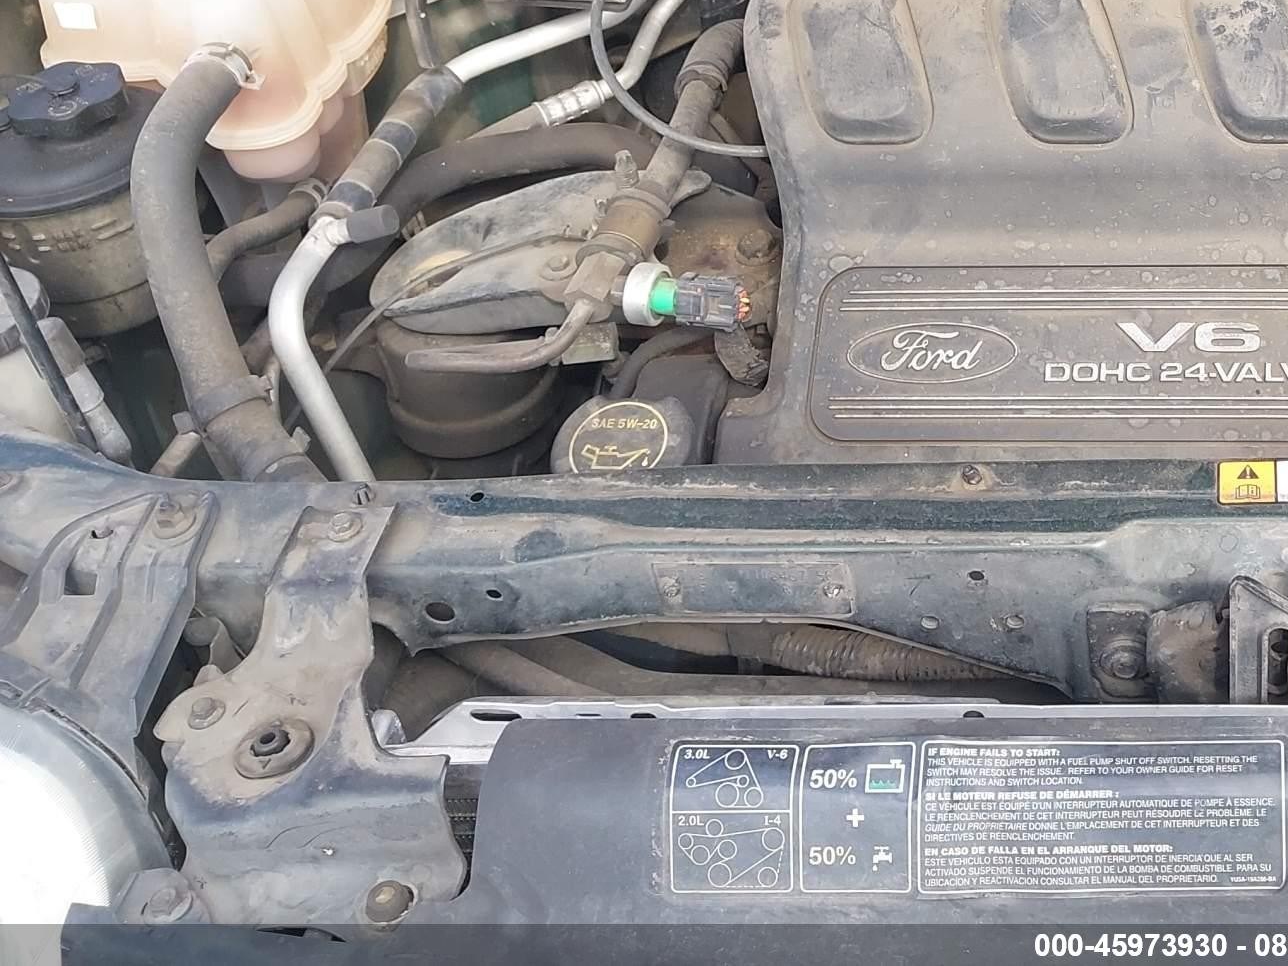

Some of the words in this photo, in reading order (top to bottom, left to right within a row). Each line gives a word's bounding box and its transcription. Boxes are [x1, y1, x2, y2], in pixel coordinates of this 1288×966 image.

[1116, 321, 1263, 352] V6
[880, 329, 983, 371] Ford
[1044, 362, 1152, 383] DOHC
[591, 418, 614, 428] SAE
[617, 418, 658, 429] 5W-20
[684, 750, 710, 759] 3.0L
[767, 750, 788, 759] V-6
[928, 748, 937, 756] IF
[940, 748, 977, 756] ENGINE
[980, 748, 1007, 756] FAILS
[1010, 748, 1024, 756] TO
[1026, 748, 1060, 756] START:
[928, 758, 945, 766] THIS
[947, 758, 983, 766] VEHICLE
[1038, 757, 1058, 765] WITH
[1060, 757, 1066, 765] A
[1068, 757, 1088, 765] FUEL
[927, 768, 958, 776] SWITCH
[960, 768, 977, 776] MAY
[979, 767, 1017, 776] RESOLVE
[1019, 767, 1034, 775] THE
[1068, 766, 1095, 774] REFER
[1098, 766, 1109, 774] TO
[1111, 766, 1134, 774] YOUR
[1136, 766, 1167, 774] OWNER
[1169, 765, 1194, 773] GUIDE
[1197, 765, 1214, 773] FOR
[809, 770, 857, 788] 50%
[926, 778, 987, 786] INSTRUCTIONS
[1008, 777, 1038, 785] SWITCH
[925, 792, 935, 800] SI
[938, 792, 950, 800] LE
[953, 791, 995, 800] MOTEUR
[999, 791, 1037, 800] REFUSE
[1040, 791, 1053, 799] DE
[925, 803, 937, 811] CE
[981, 802, 997, 810] EST
[1054, 800, 1118, 809] INTERRUPTEUR
[1119, 799, 1179, 808] AUTOMATIQUE
[1181, 799, 1192, 807] DE
[1194, 799, 1224, 807] POMPE
[678, 816, 704, 825] 2.0L
[925, 813, 936, 821] LE
[1023, 812, 1035, 820] DE
[1037, 812, 1053, 820] CET
[1055, 811, 1119, 820] INTERRUPTEUR
[1122, 811, 1144, 819] PEUT
[1256, 809, 1267, 817] LE
[925, 824, 951, 832] GUIDE
[953, 823, 965, 831] DU
[1029, 822, 1058, 830] DONNE
[1131, 821, 1142, 829] DE
[1144, 821, 1162, 829] CET
[1164, 820, 1228, 829] INTERRUPTEUR
[1230, 820, 1239, 828] ET
[1242, 820, 1259, 828] DES
[925, 833, 975, 842] DIRECTIVES
[977, 833, 988, 841] DE
[809, 847, 856, 865] 50%
[925, 847, 938, 856] EN
[941, 847, 968, 855] CASO
[972, 847, 985, 855] DE
[989, 847, 1018, 855] FALLA
[1022, 847, 1034, 855] EN
[1038, 846, 1050, 855] EL
[1052, 846, 1109, 854] ARRANQUE
[1111, 846, 1130, 854] DEL
[1134, 845, 1173, 854] MOTOR:
[925, 858, 946, 866] ESTE
[1015, 856, 1057, 865] EQUIPADO
[1059, 856, 1078, 864] CON
[1080, 856, 1092, 864] UN
[1094, 855, 1155, 864] INTERRUPTOR
[1156, 855, 1167, 863] DE
[1204, 854, 1222, 862] QUE
[1224, 854, 1233, 862] AL
[1236, 854, 1252, 862] SER
[925, 868, 966, 876] ACTIVADO
[968, 867, 1013, 876] SUSPENDE
[1016, 867, 1025, 875] EL
[1027, 866, 1102, 875] FUNCIONAMIENTO
[1104, 866, 1114, 874] DE
[1117, 866, 1127, 874] LA
[1129, 865, 1158, 873] BOMBA
[1160, 865, 1172, 873] DE
[1237, 864, 1258, 872] PARA
[1260, 864, 1271, 872] SU
[972, 878, 977, 886] Y
[1041, 876, 1089, 885] CONSULTAR
[1091, 876, 1102, 884] EL
[1103, 875, 1137, 884] MANUAL
[1139, 875, 1155, 883] DEL
